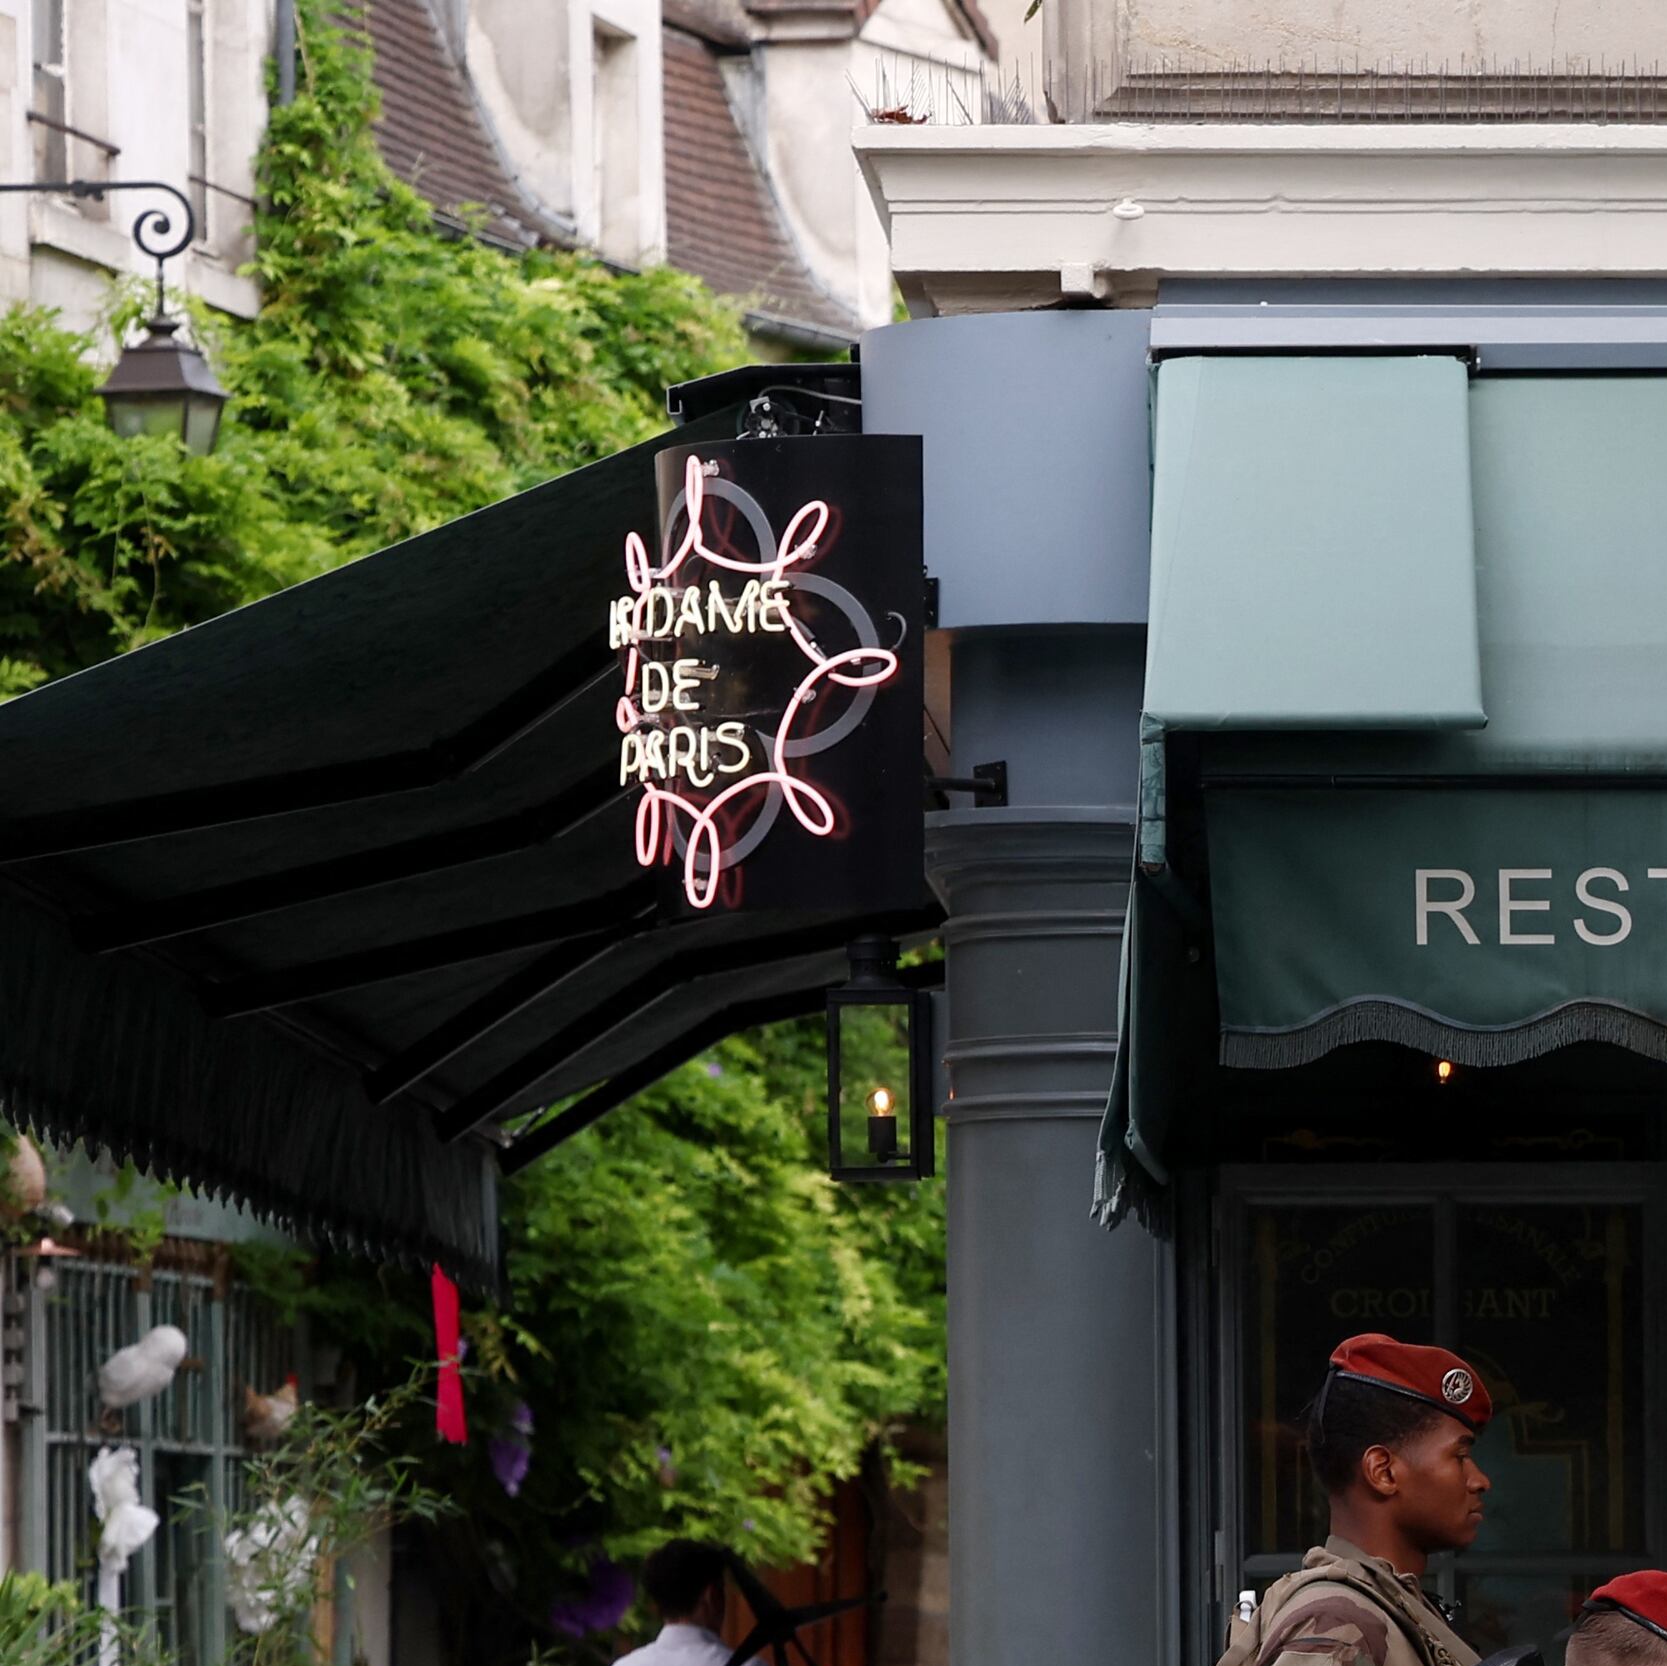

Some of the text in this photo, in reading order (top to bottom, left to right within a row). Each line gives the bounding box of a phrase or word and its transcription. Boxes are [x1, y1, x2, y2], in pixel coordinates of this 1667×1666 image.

[647, 579, 790, 636] DAME
[641, 658, 701, 712] DE
[619, 722, 751, 788] PARIS
